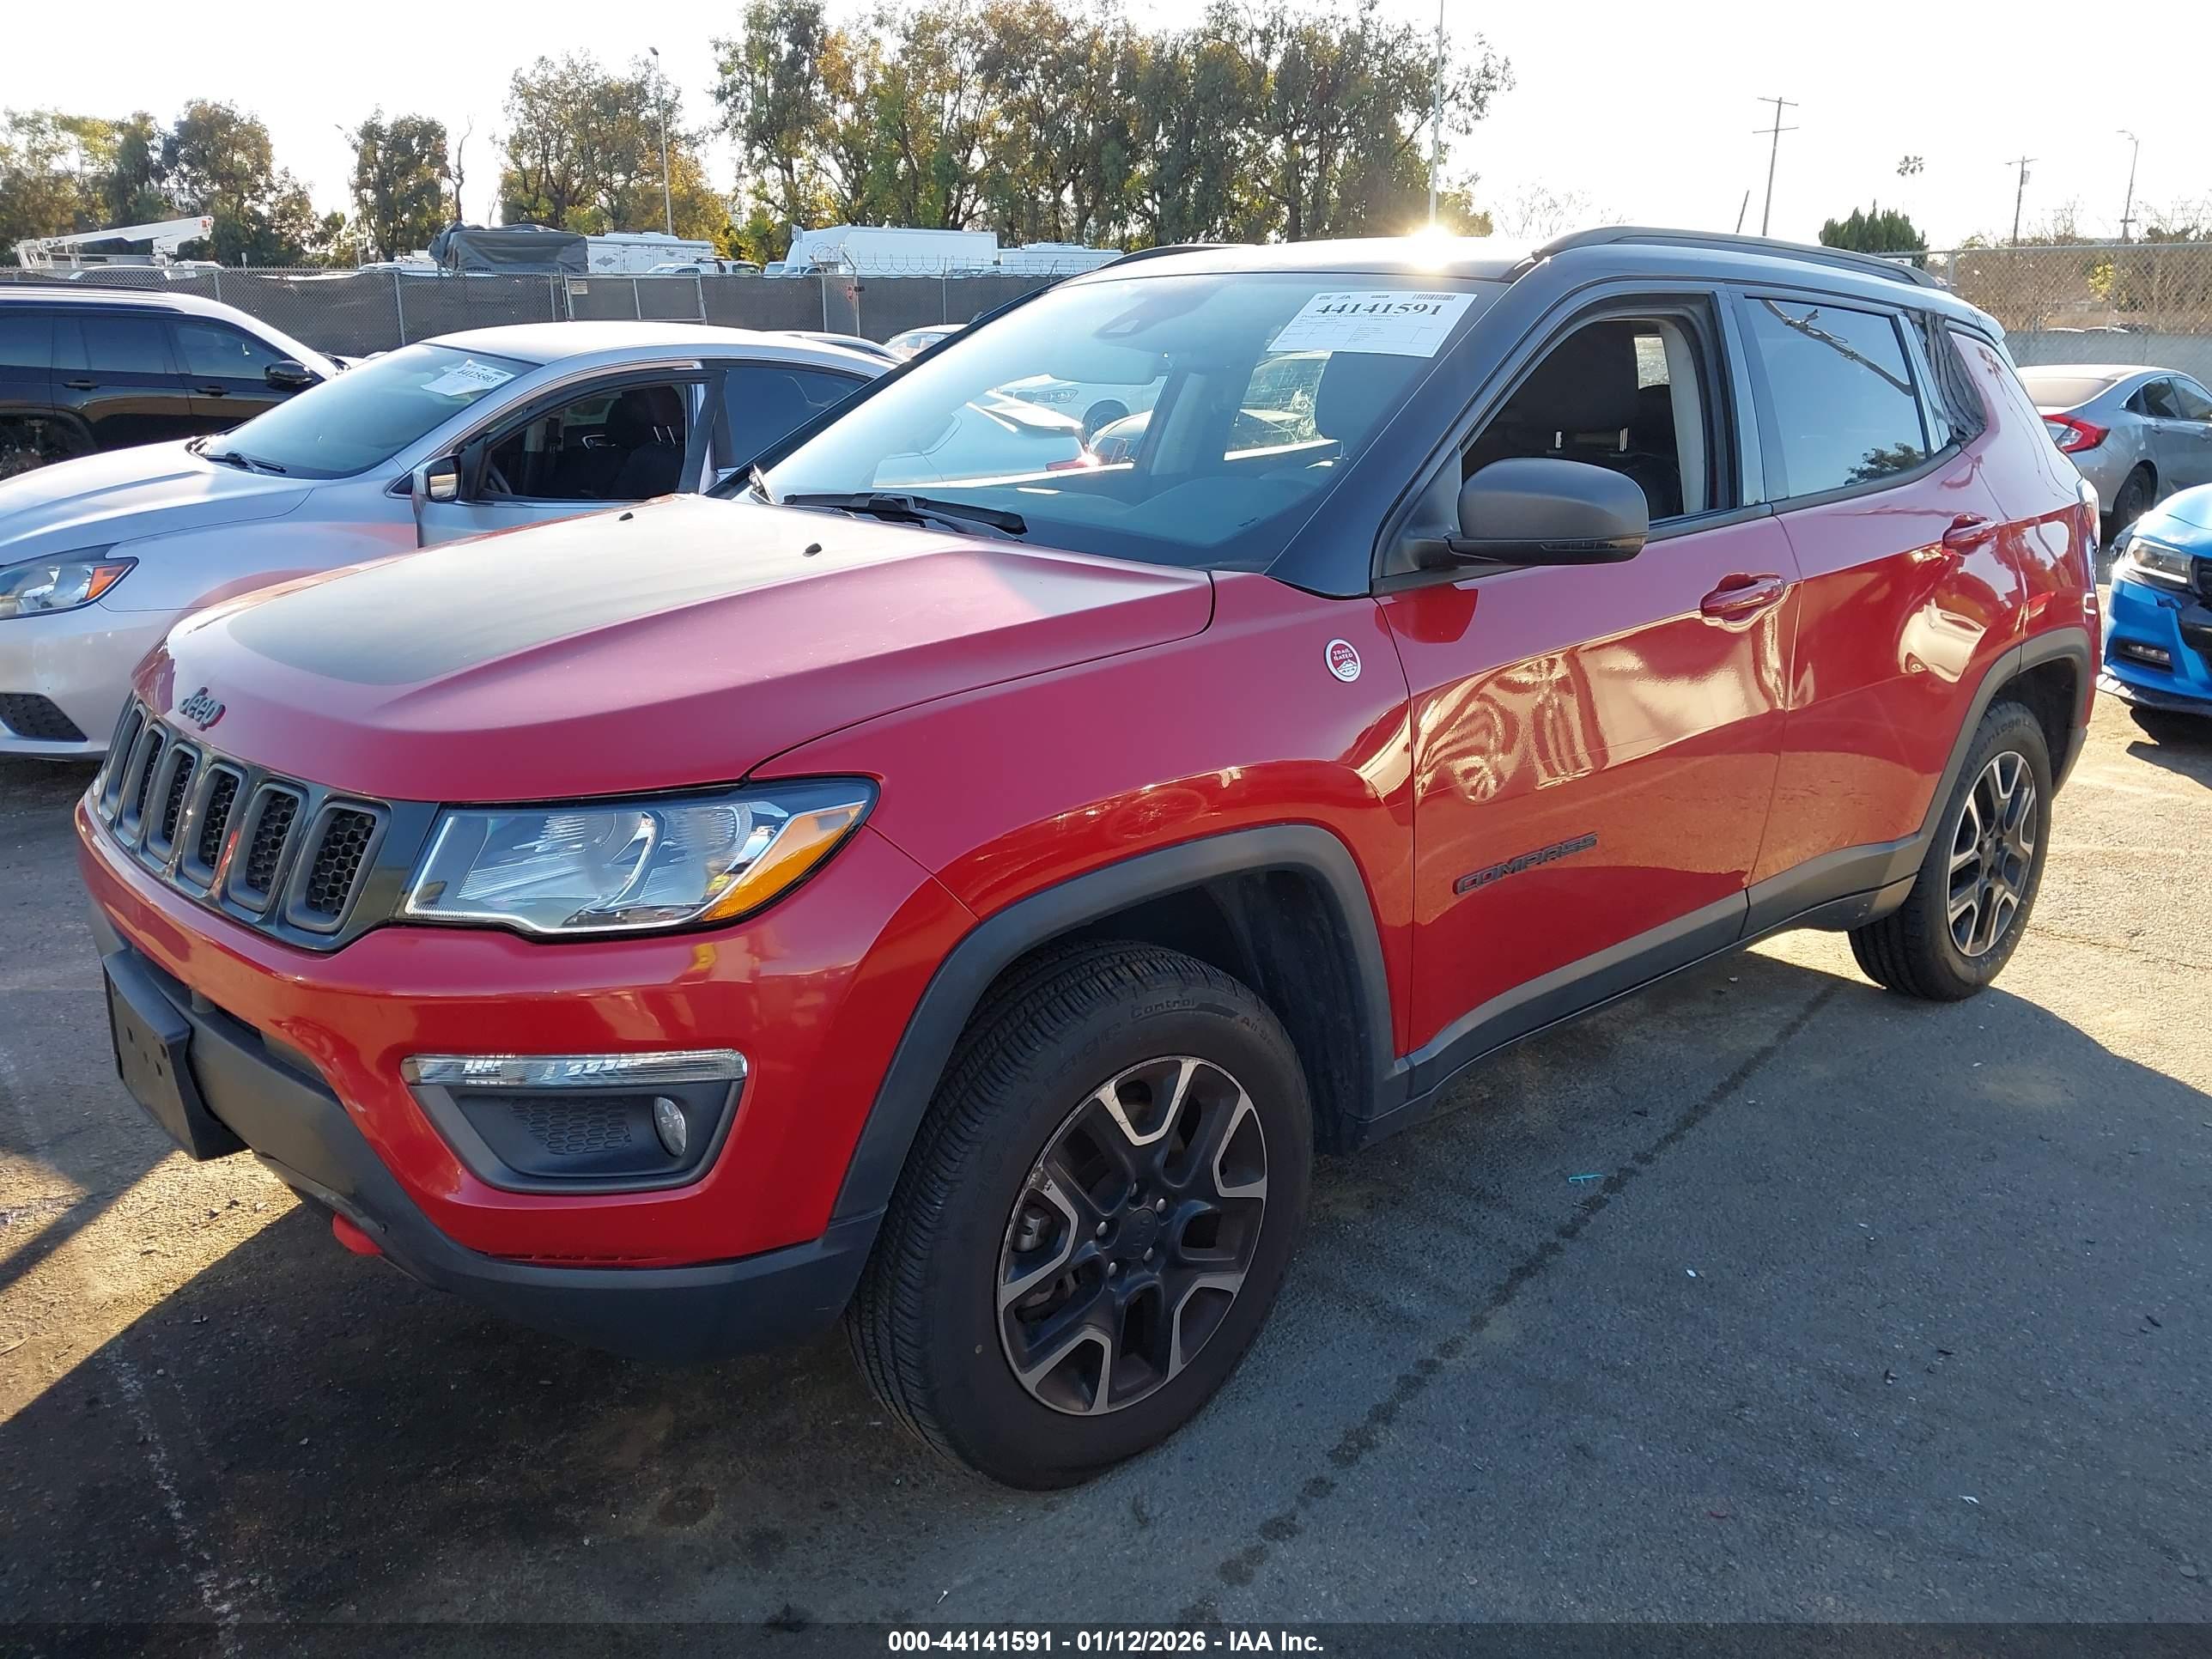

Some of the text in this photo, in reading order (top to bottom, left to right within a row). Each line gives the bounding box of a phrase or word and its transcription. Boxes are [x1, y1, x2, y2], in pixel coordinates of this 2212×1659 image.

[1316, 302, 1443, 316] 44141591
[1334, 653, 1353, 661] RATED
[179, 687, 226, 732] Jeep
[1452, 831, 1598, 895] COMPASS
[1130, 998, 1195, 1019] Control
